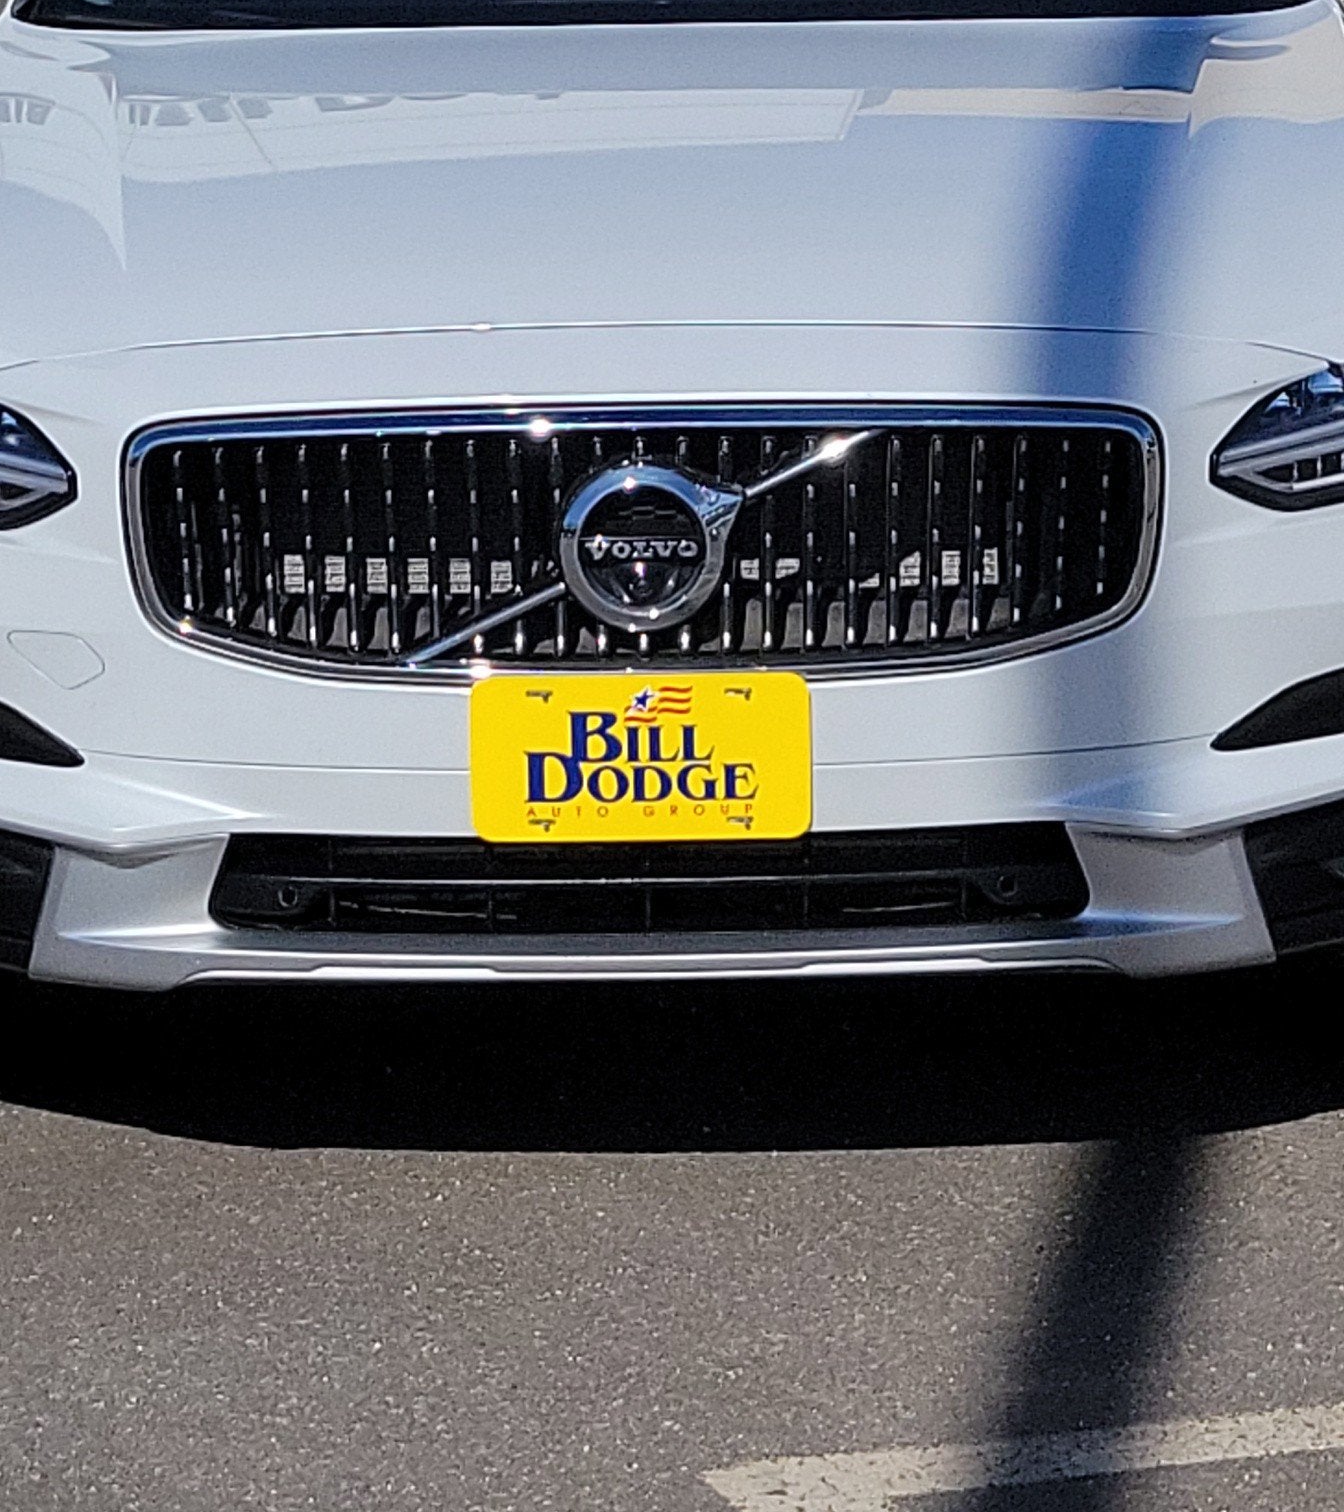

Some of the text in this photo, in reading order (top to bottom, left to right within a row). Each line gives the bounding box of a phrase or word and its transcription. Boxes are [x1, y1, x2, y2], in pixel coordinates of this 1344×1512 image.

[585, 539, 698, 560] VOLVO
[567, 710, 716, 763] BILL
[523, 750, 759, 803] DODGE
[526, 803, 754, 818] AUTO GROUP
